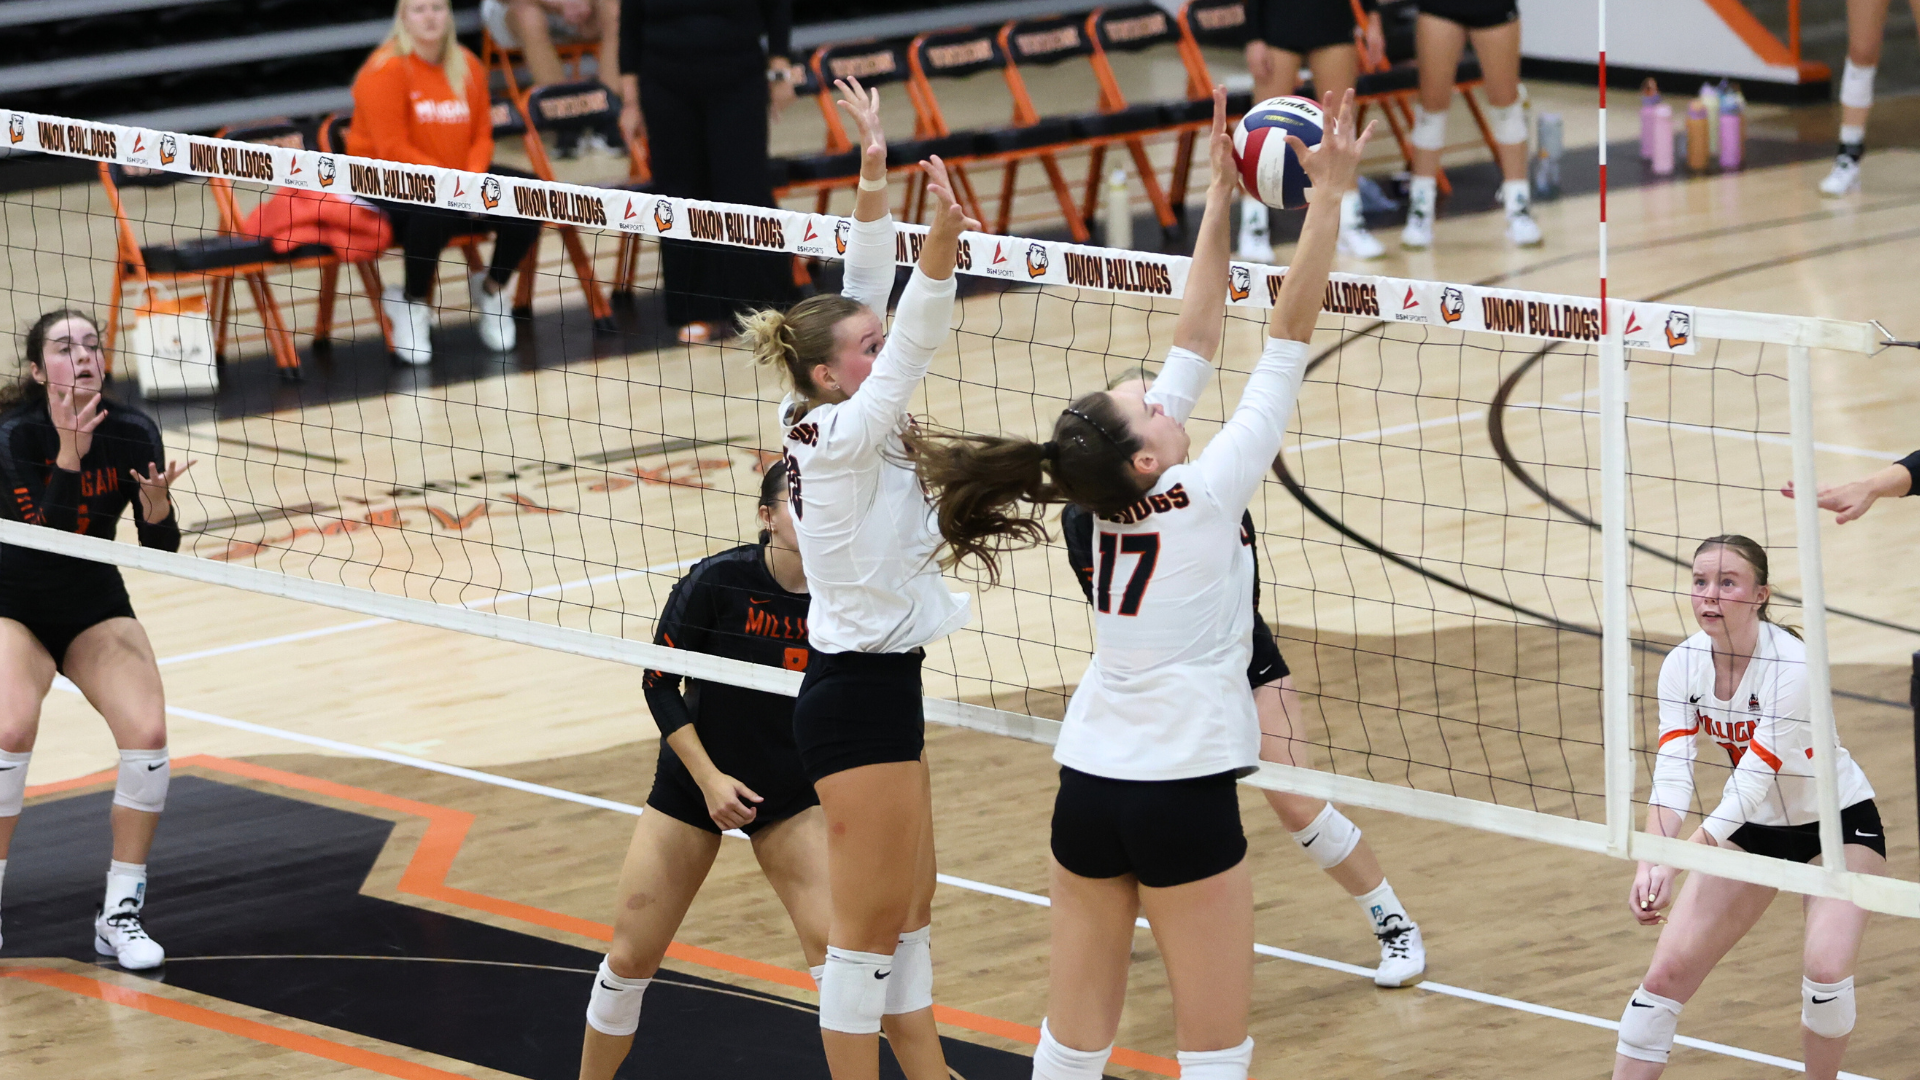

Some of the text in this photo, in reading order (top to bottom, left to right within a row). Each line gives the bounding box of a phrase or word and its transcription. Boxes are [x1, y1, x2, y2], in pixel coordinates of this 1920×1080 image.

[37, 121, 117, 159] UNION BULLDOGS
[189, 142, 274, 181] UNION BULLDOGS
[349, 163, 436, 204] UNION BULLDOGS
[513, 185, 608, 226] UNION BULLDOGS
[687, 207, 786, 249] UNION BULLDOGS
[1064, 252, 1173, 296] UNION BULLDOGS
[1322, 280, 1380, 317] ULLDOGS
[1481, 296, 1600, 342] UNION BULLDOGS
[1097, 531, 1161, 617] 17
